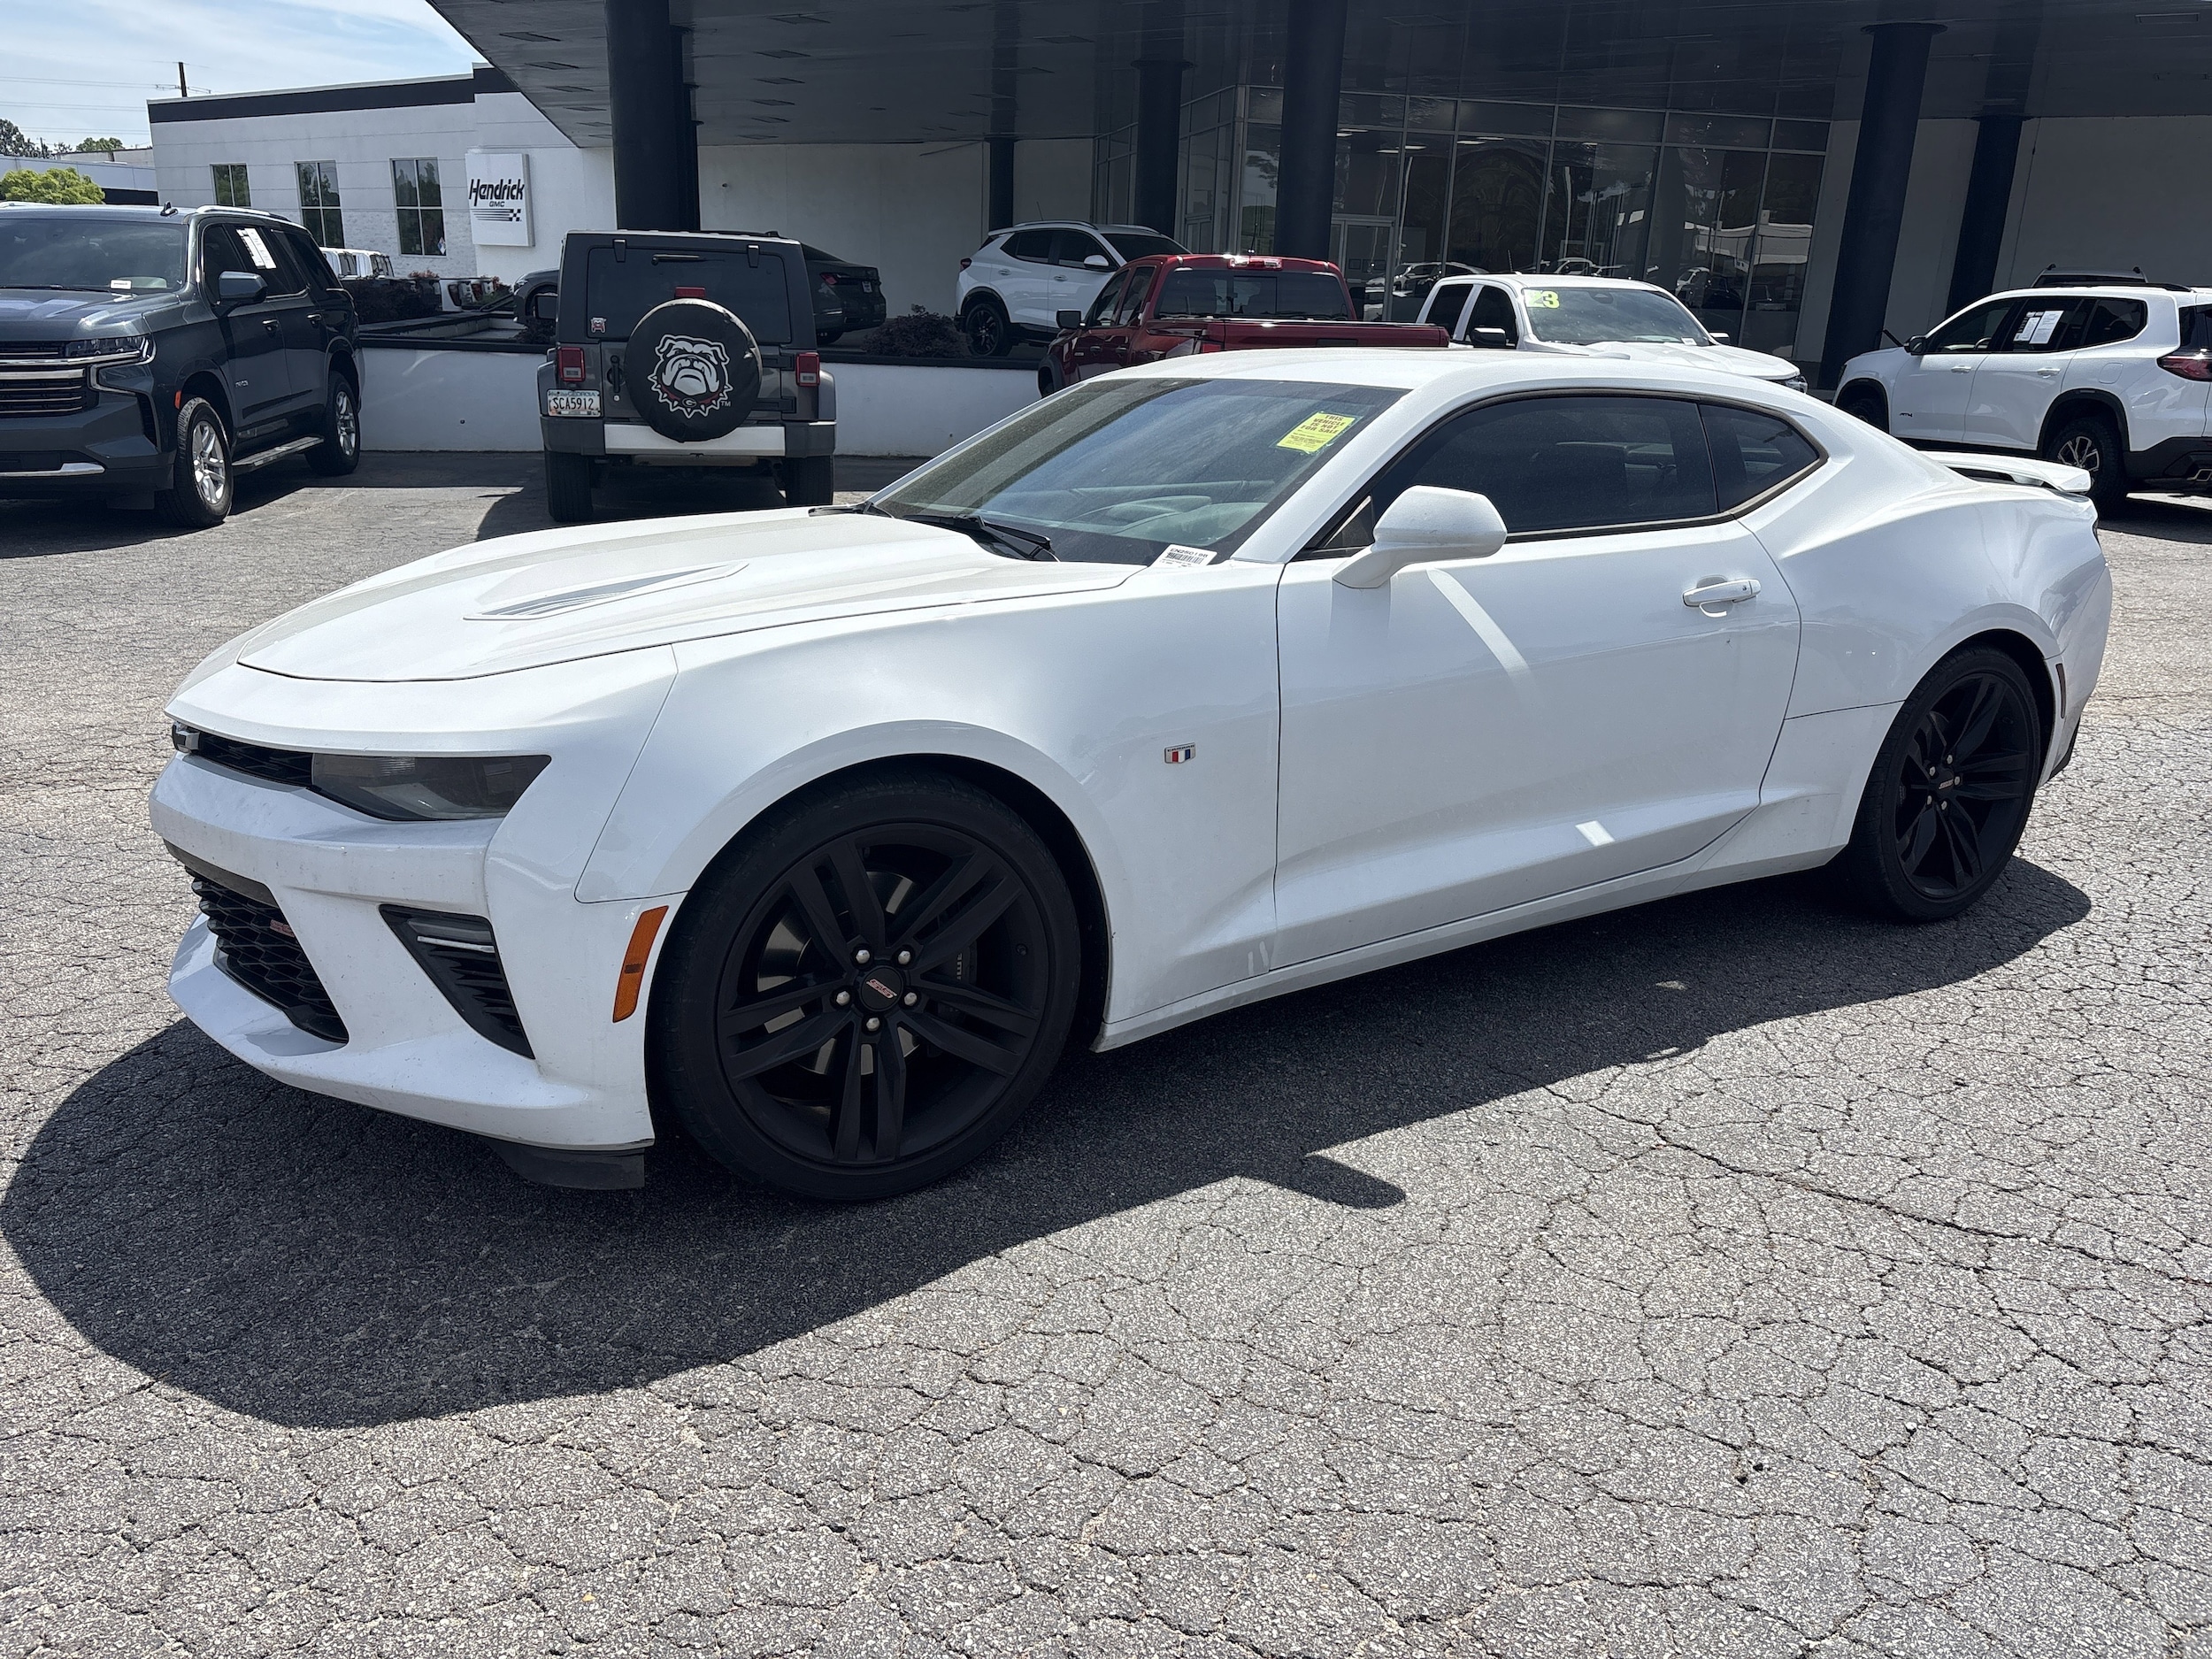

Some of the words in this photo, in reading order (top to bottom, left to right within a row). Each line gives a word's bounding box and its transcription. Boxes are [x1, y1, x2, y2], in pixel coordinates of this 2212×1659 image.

[468, 179, 525, 207] Hendrick
[552, 397, 595, 411] SCA5912
[1313, 418, 1346, 426] VEHICLE
